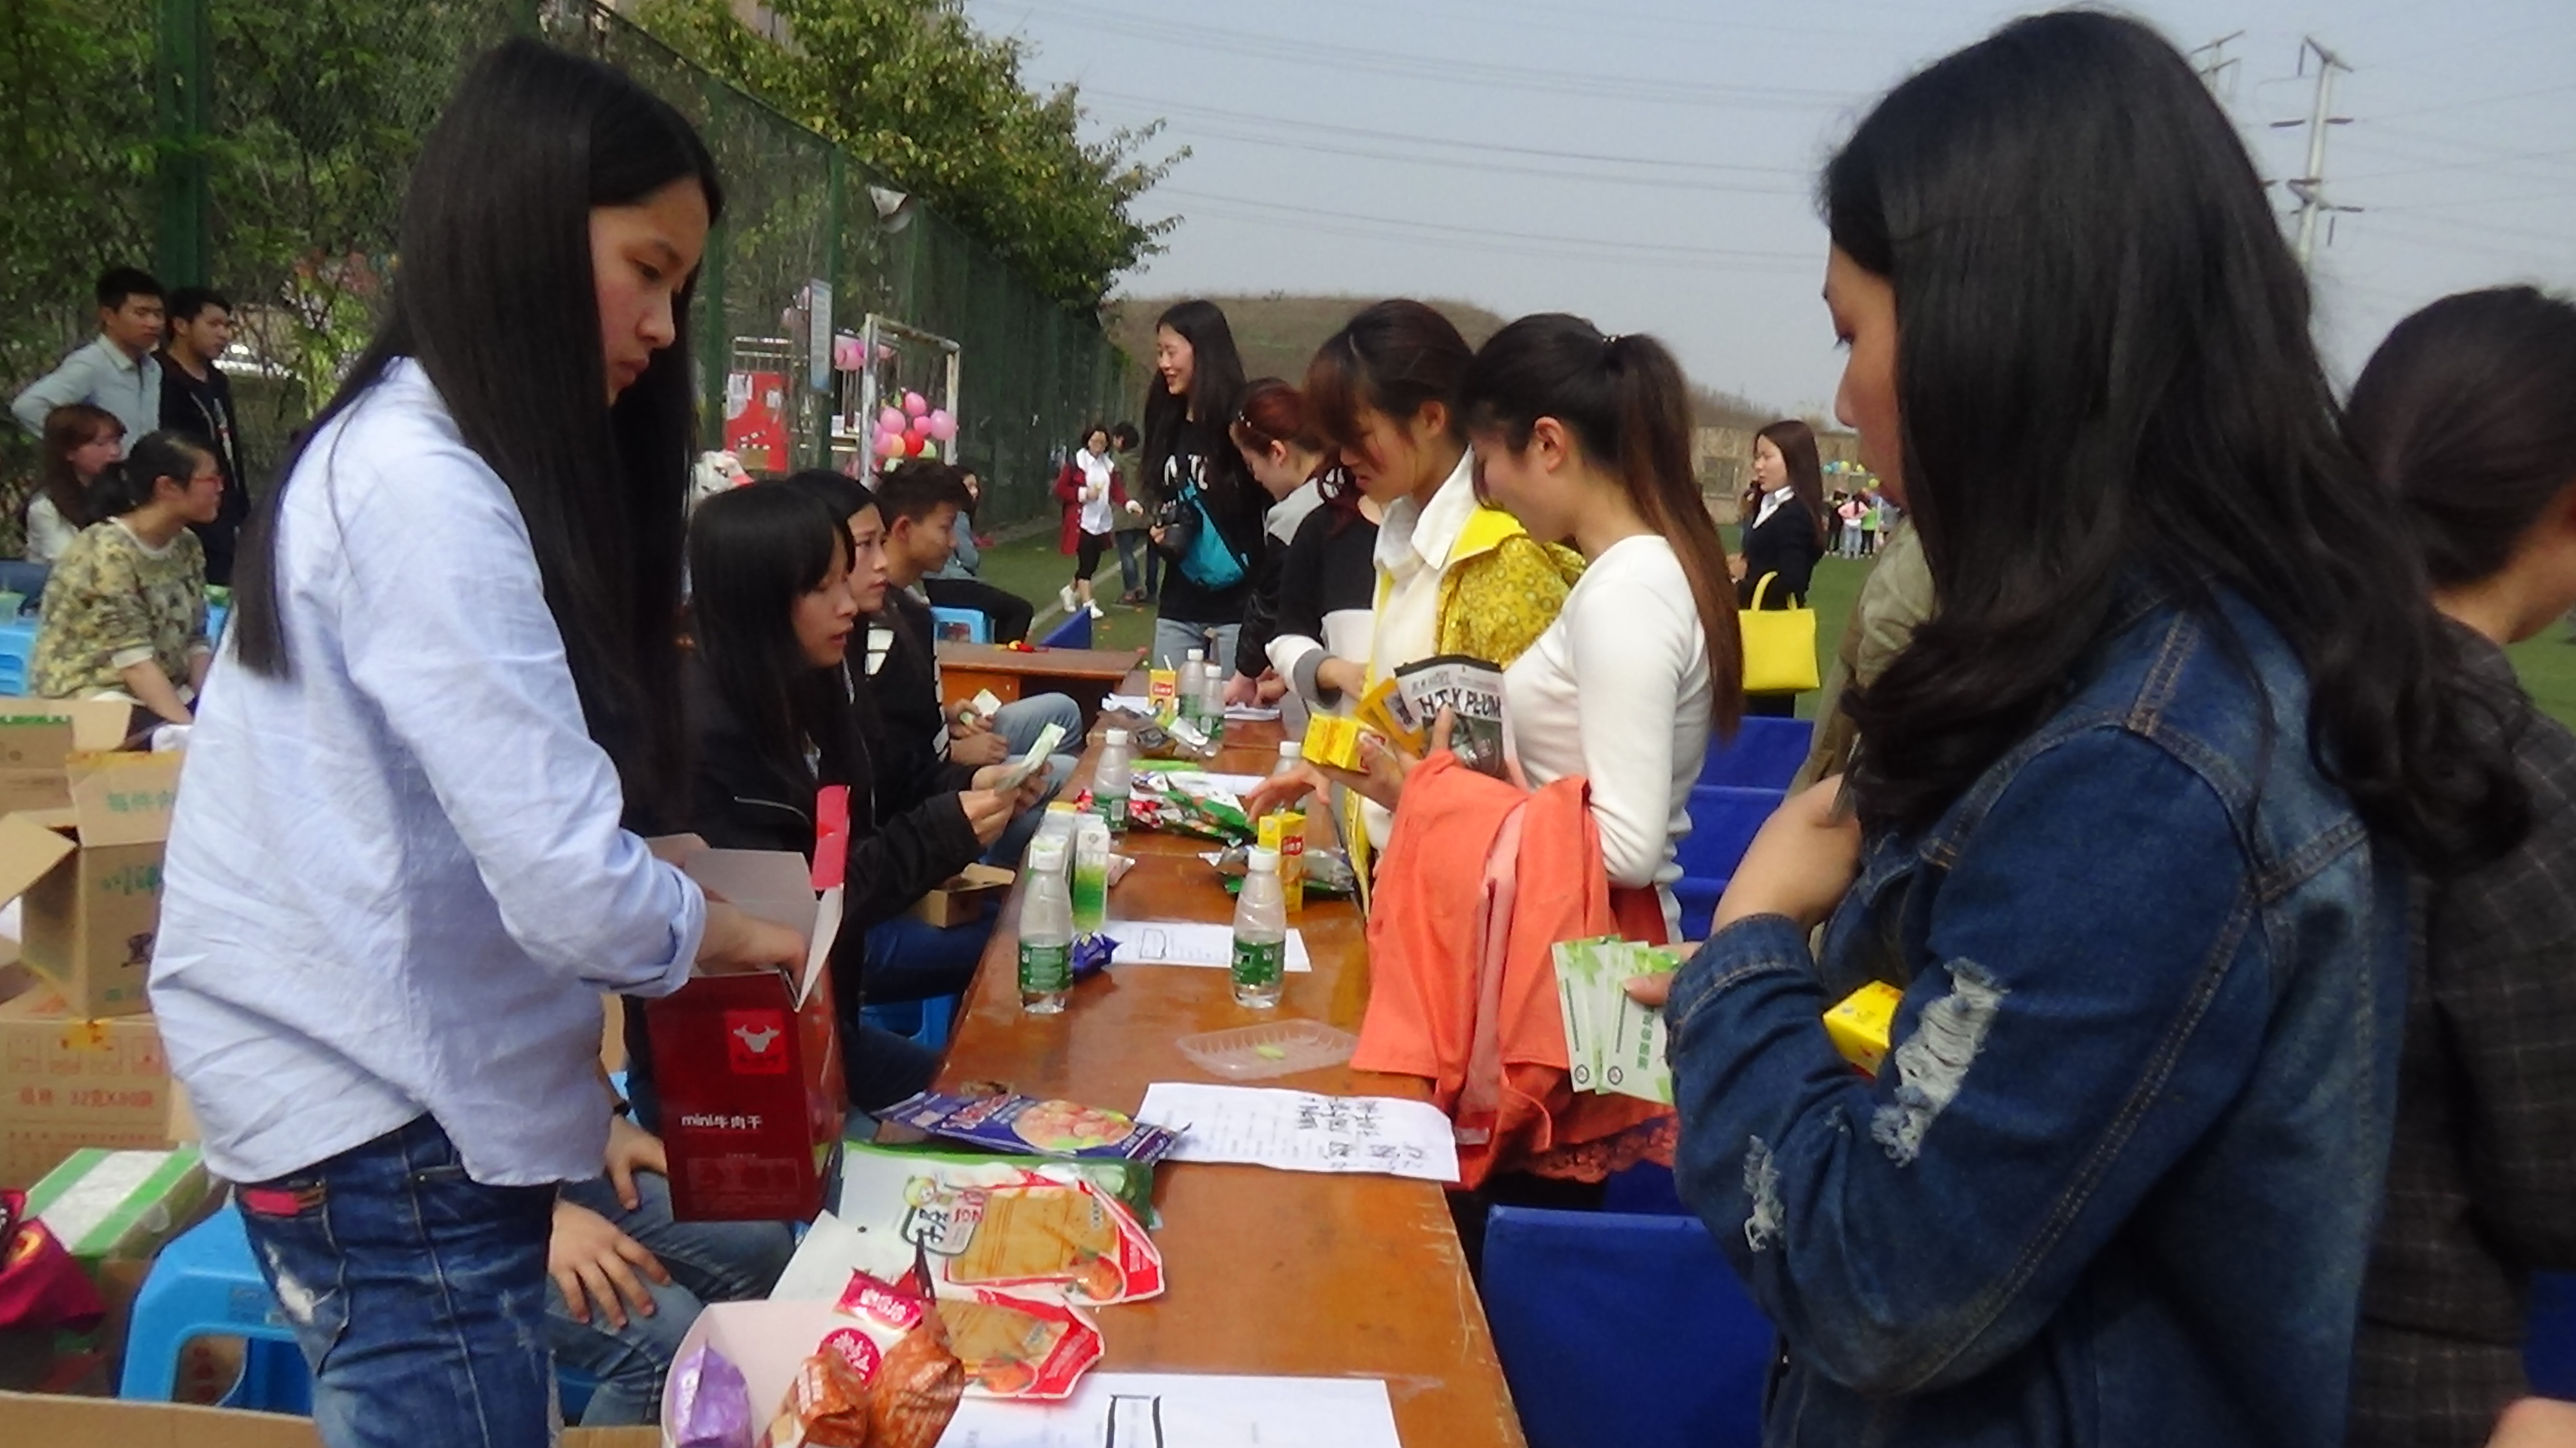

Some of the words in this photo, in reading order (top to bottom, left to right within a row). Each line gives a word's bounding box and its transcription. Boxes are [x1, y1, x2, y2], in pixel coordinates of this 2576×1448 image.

[1465, 690, 1501, 718] PLUM
[682, 1113, 762, 1129] mini牛肉干
